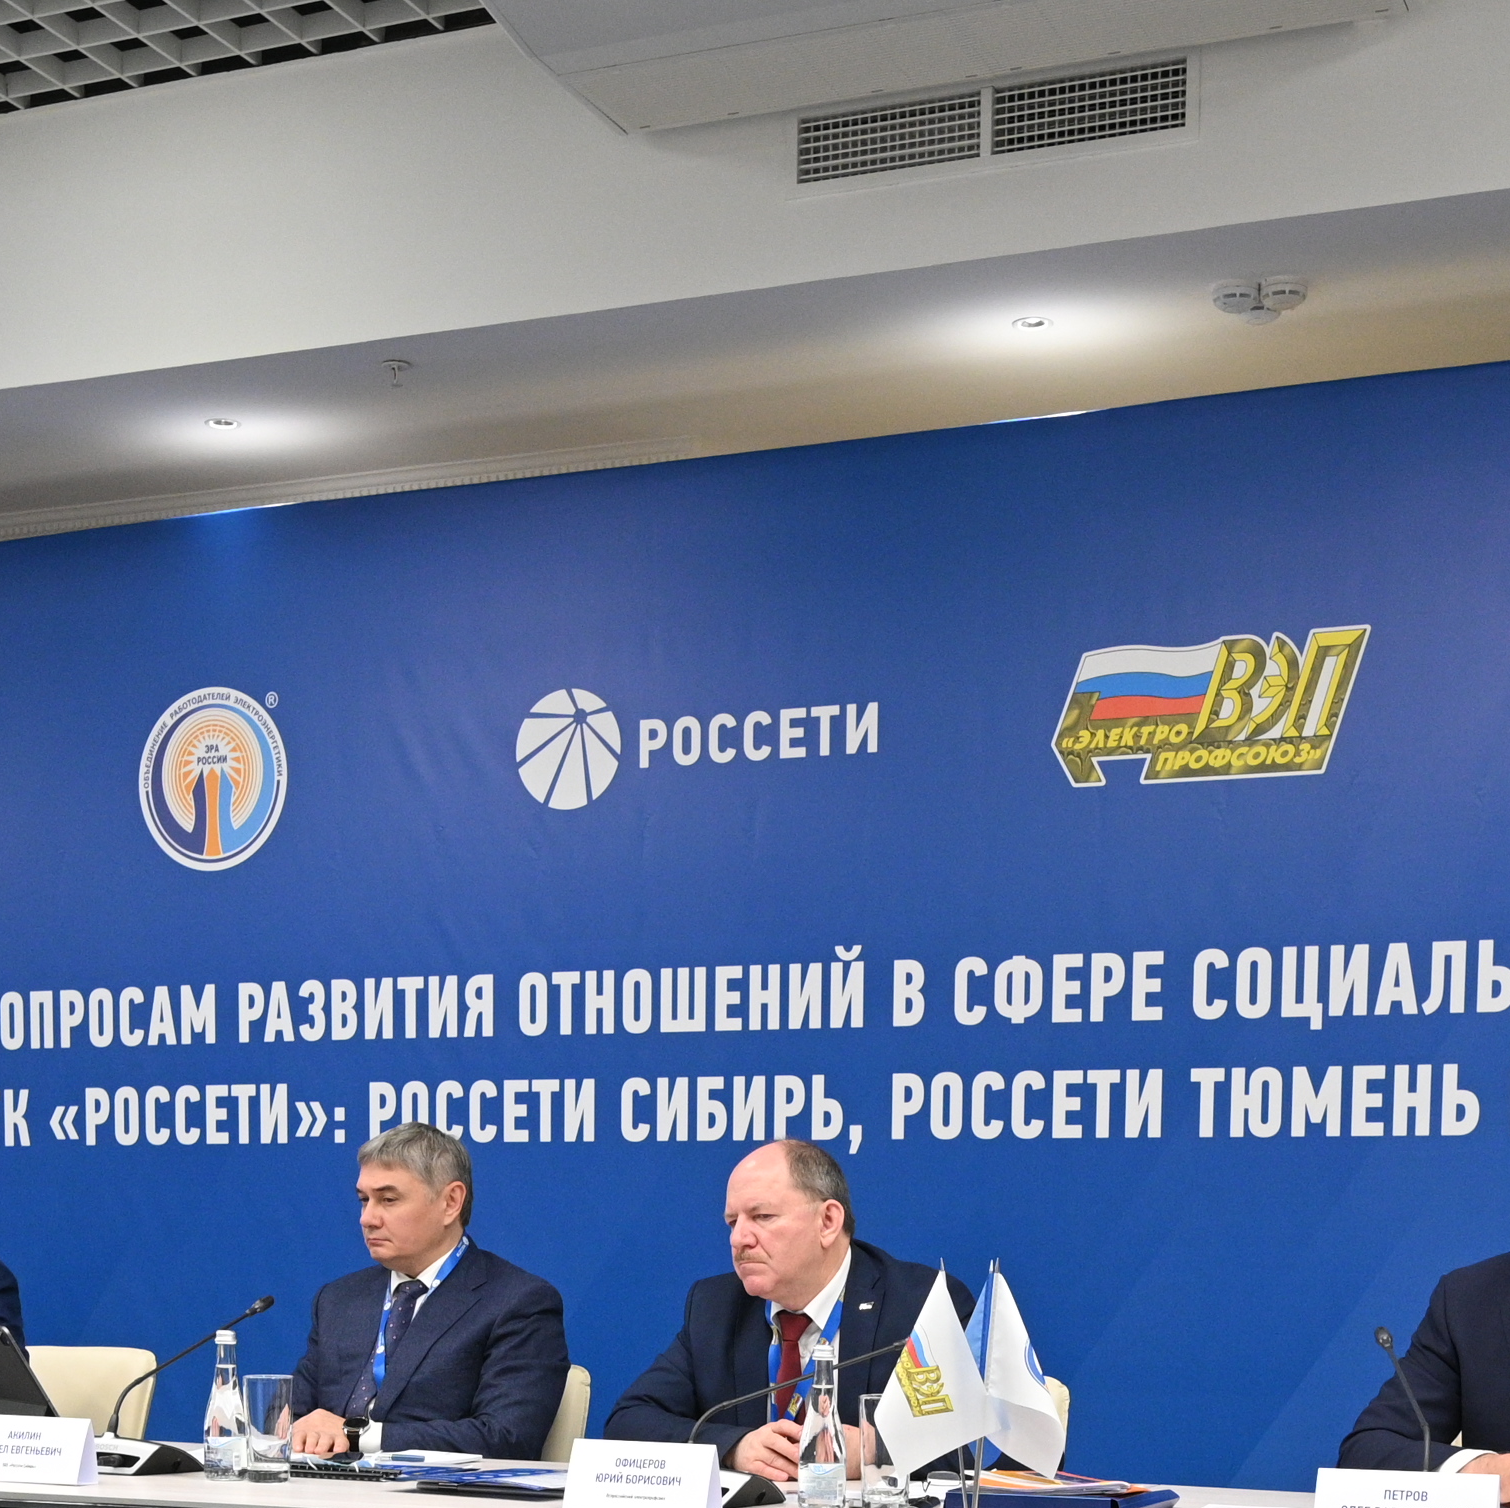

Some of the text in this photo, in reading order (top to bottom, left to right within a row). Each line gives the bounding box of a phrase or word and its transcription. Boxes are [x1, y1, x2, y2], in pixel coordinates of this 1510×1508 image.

[1192, 628, 1366, 741] ВЭП
[143, 692, 283, 789] ОБЪЕДИНЕНИЕ РАБОТОДАТЕЛЕЙ ЭЛЕКТРОЭНЕРГЕТИКИ
[639, 702, 879, 769] РОССЕТИ
[204, 744, 220, 753] ЭРА
[1155, 744, 1321, 771] ПРОФСОЮЗ»
[197, 754, 227, 766] РОССИИ
[238, 973, 494, 1043] РАЗВИТИЯ
[518, 944, 865, 1037] ОТНОШЕНИЙ
[892, 959, 925, 1027] В
[954, 950, 1165, 1026] СФЕРЕ
[49, 1083, 346, 1146] «РОССЕТИ»:
[362, 1078, 595, 1144] РОССЕТИ
[620, 1074, 863, 1155] СИБИРЬ,
[891, 1068, 1163, 1140] РОССЕТИ
[1190, 1063, 1480, 1138] ТЮМЕНЬ
[7, 1430, 42, 1441] АКИЛИН
[10, 1443, 62, 1457] ЕВГЕНЬЕВИЧ
[615, 1457, 666, 1471] ОФИЦЕРОВ
[595, 1469, 682, 1487] ЮРИЙ БОРИСОВИЧ
[1383, 1488, 1428, 1502] ПЕТРОВ
